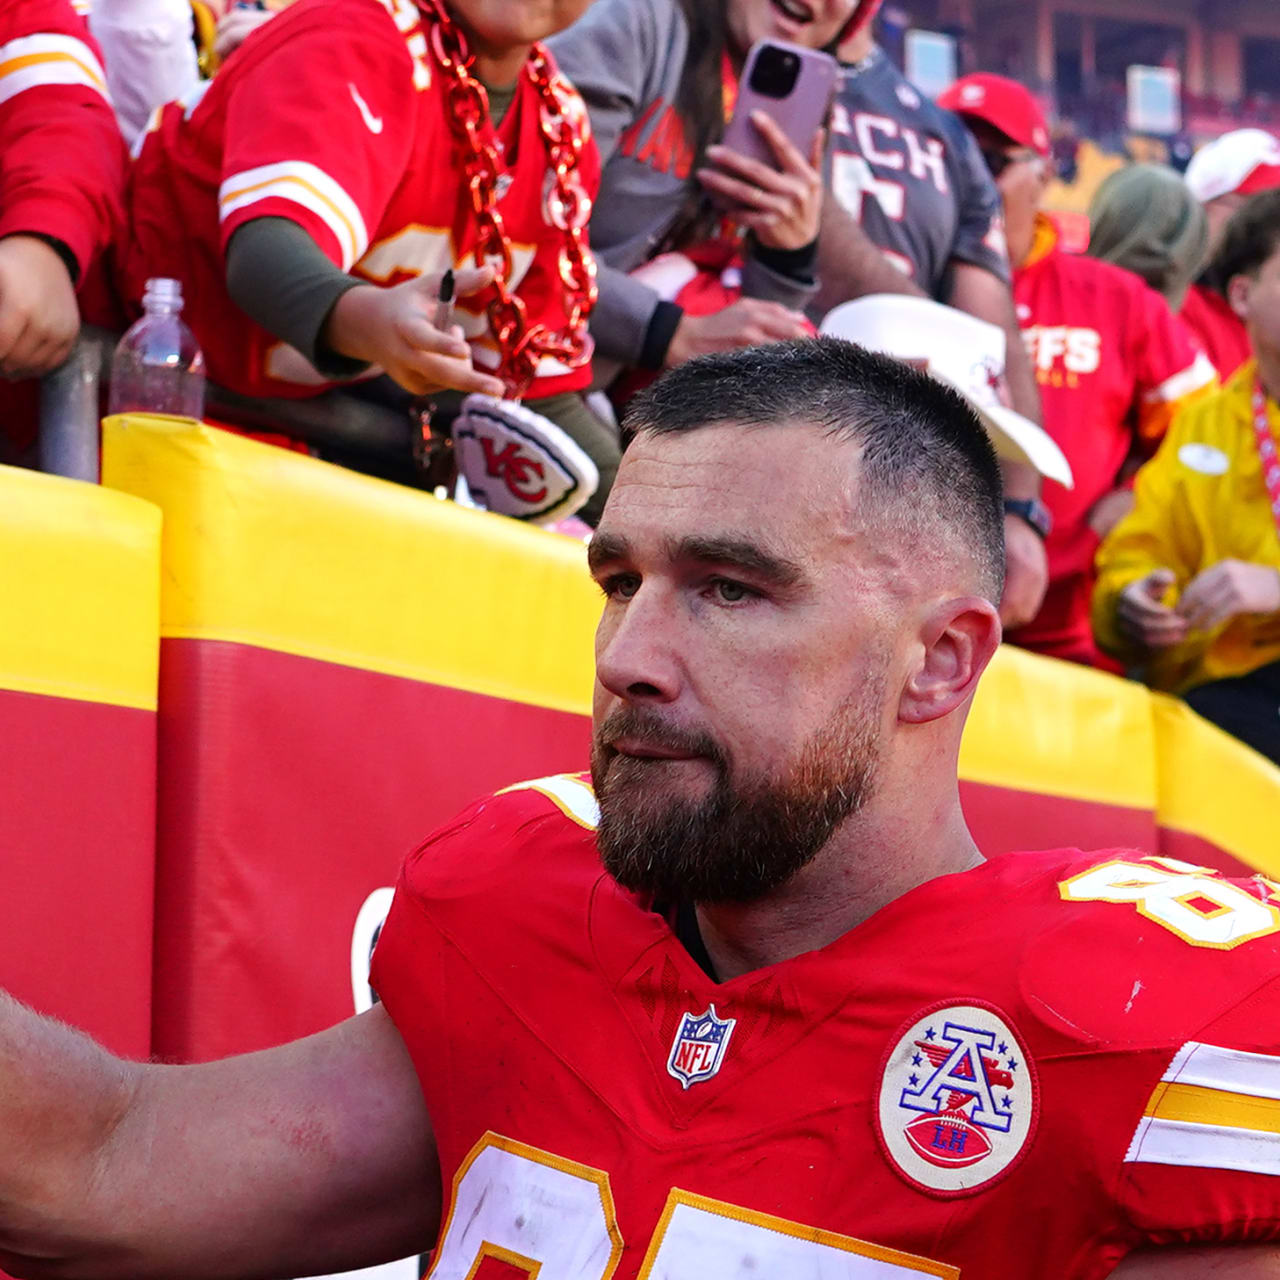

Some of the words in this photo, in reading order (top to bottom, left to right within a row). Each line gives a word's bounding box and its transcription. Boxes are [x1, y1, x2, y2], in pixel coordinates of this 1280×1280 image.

[480, 437, 548, 504] KC
[675, 1042, 712, 1074] NFL
[899, 1021, 1013, 1133] A
[931, 1126, 968, 1153] LH
